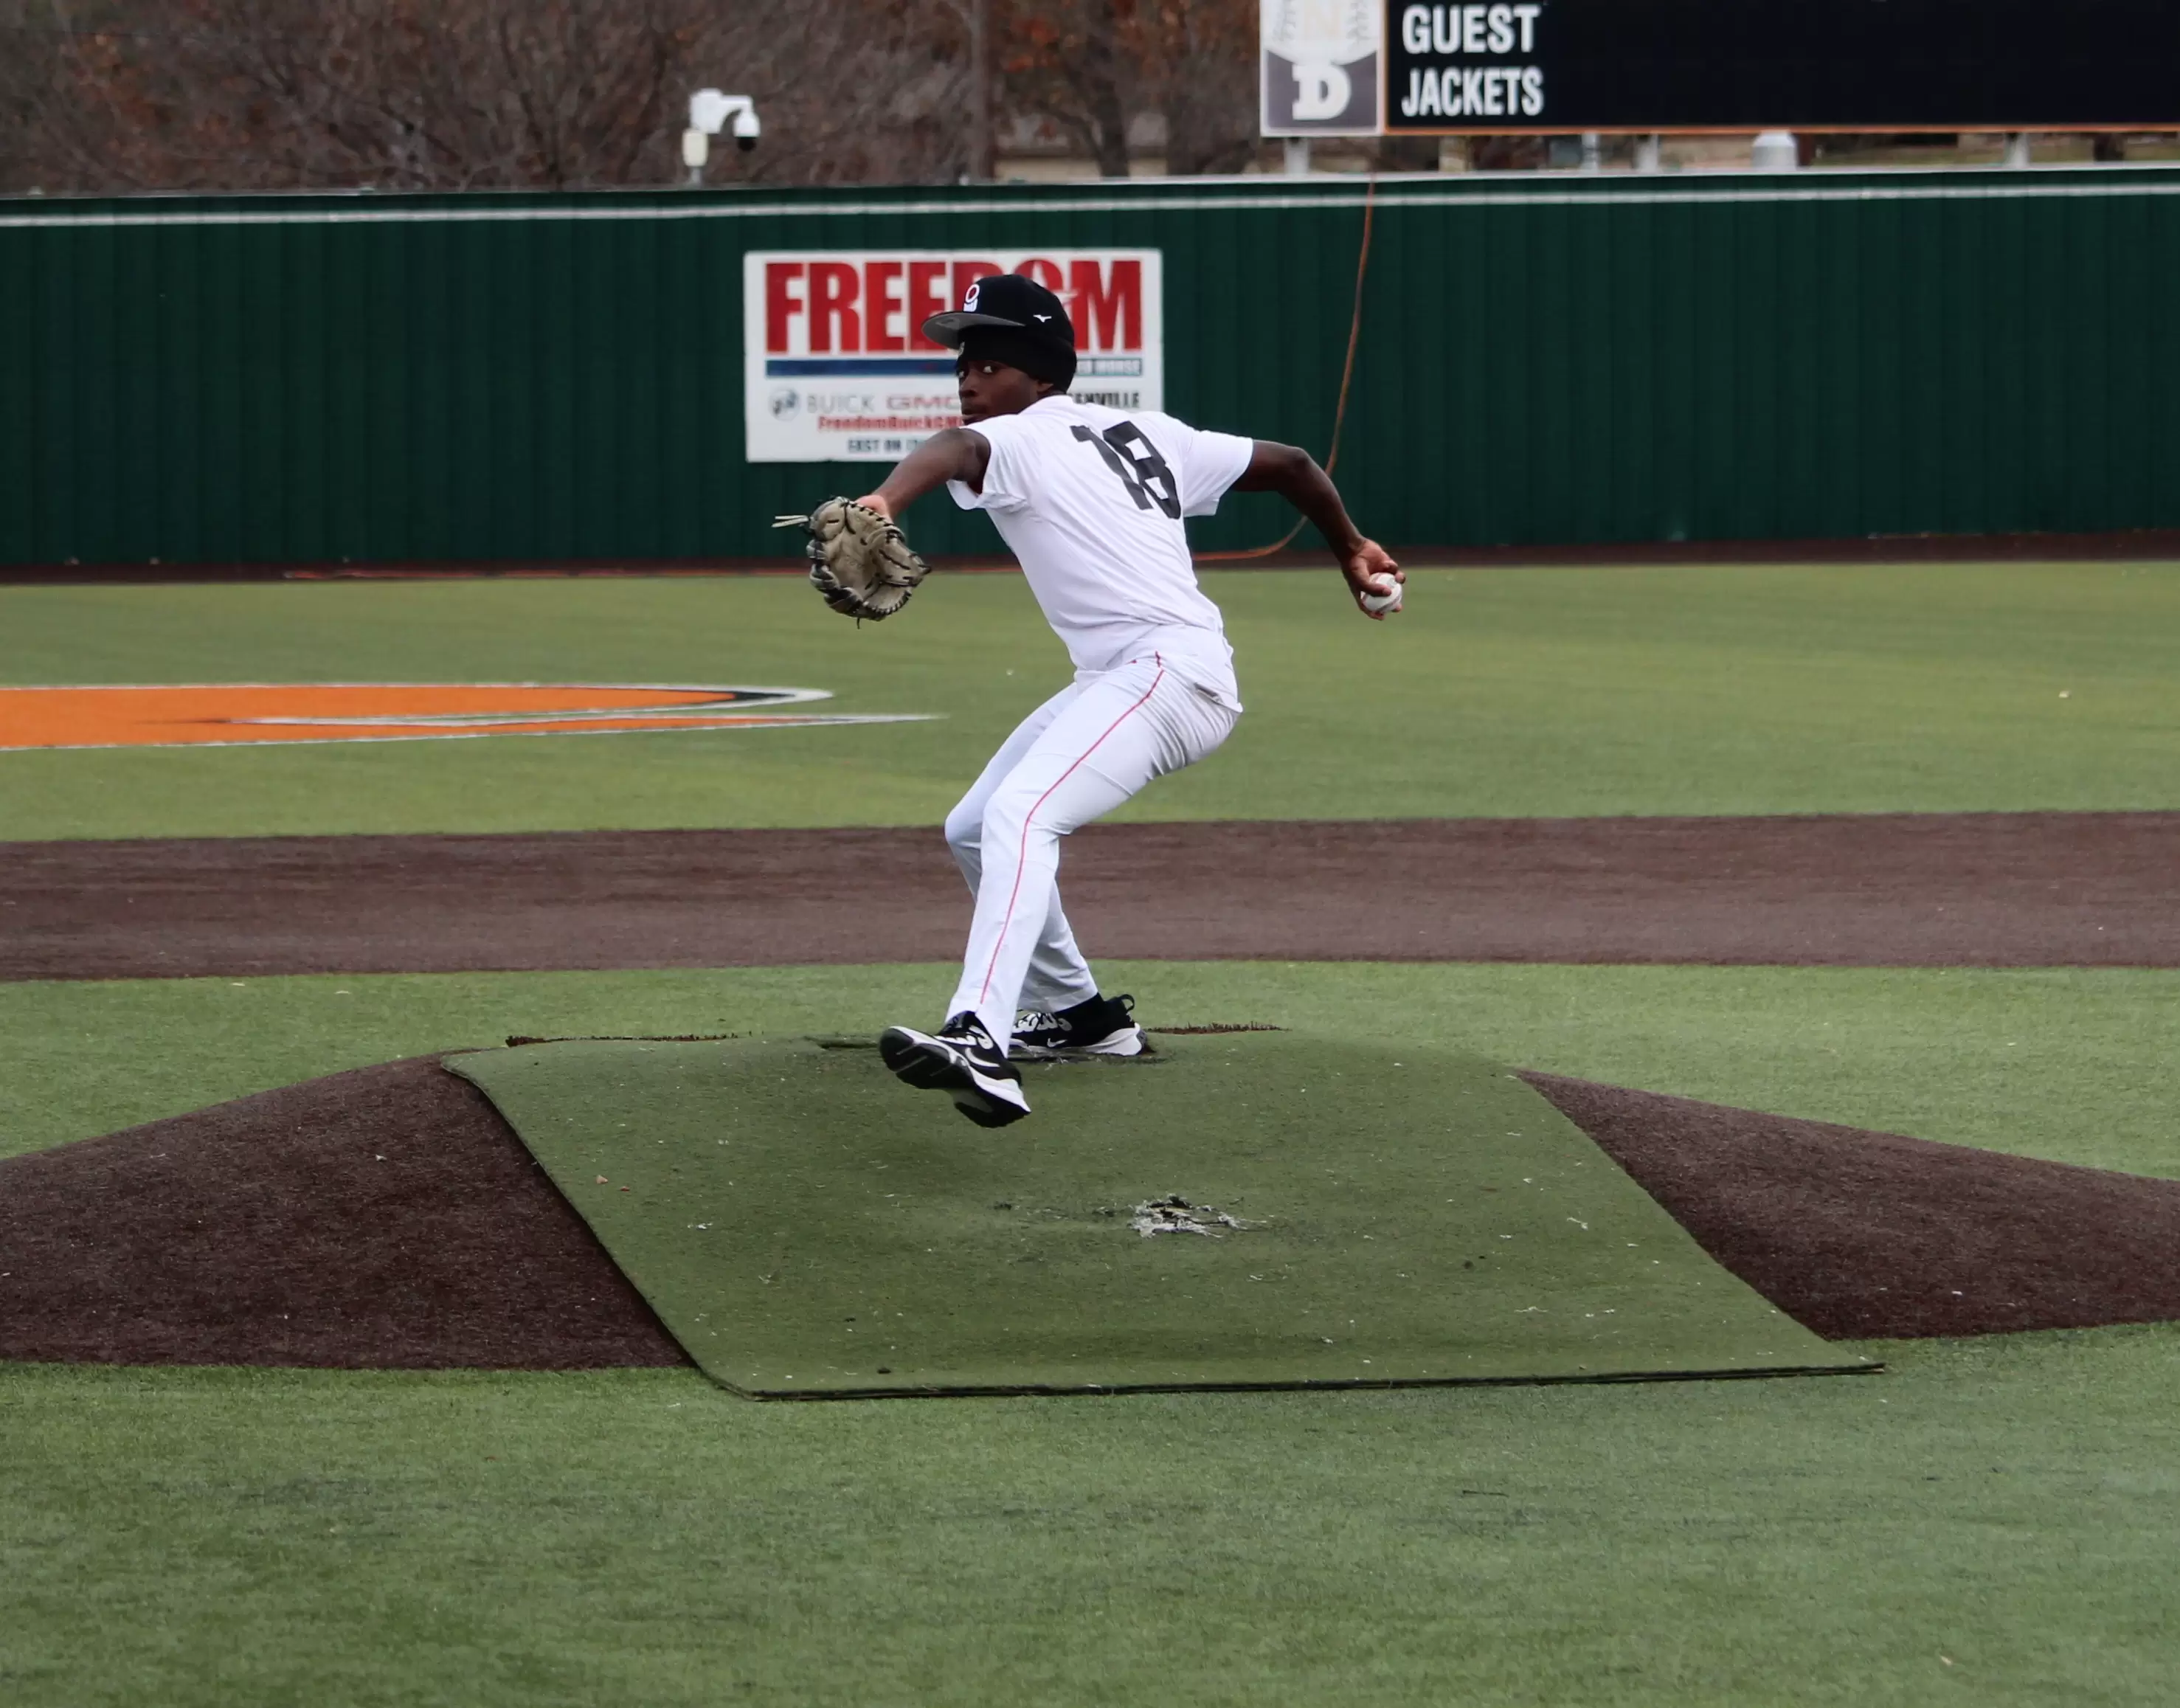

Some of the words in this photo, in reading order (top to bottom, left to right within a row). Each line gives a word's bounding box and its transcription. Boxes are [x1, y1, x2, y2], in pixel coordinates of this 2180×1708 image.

[1402, 4, 1540, 54] GUEST
[1292, 63, 1352, 120] D
[1402, 66, 1545, 117] JACKETS
[807, 395, 876, 413] BUICK
[887, 395, 961, 411] GMC
[817, 415, 963, 432] FreedomBuickGM
[1070, 421, 1181, 519] 18
